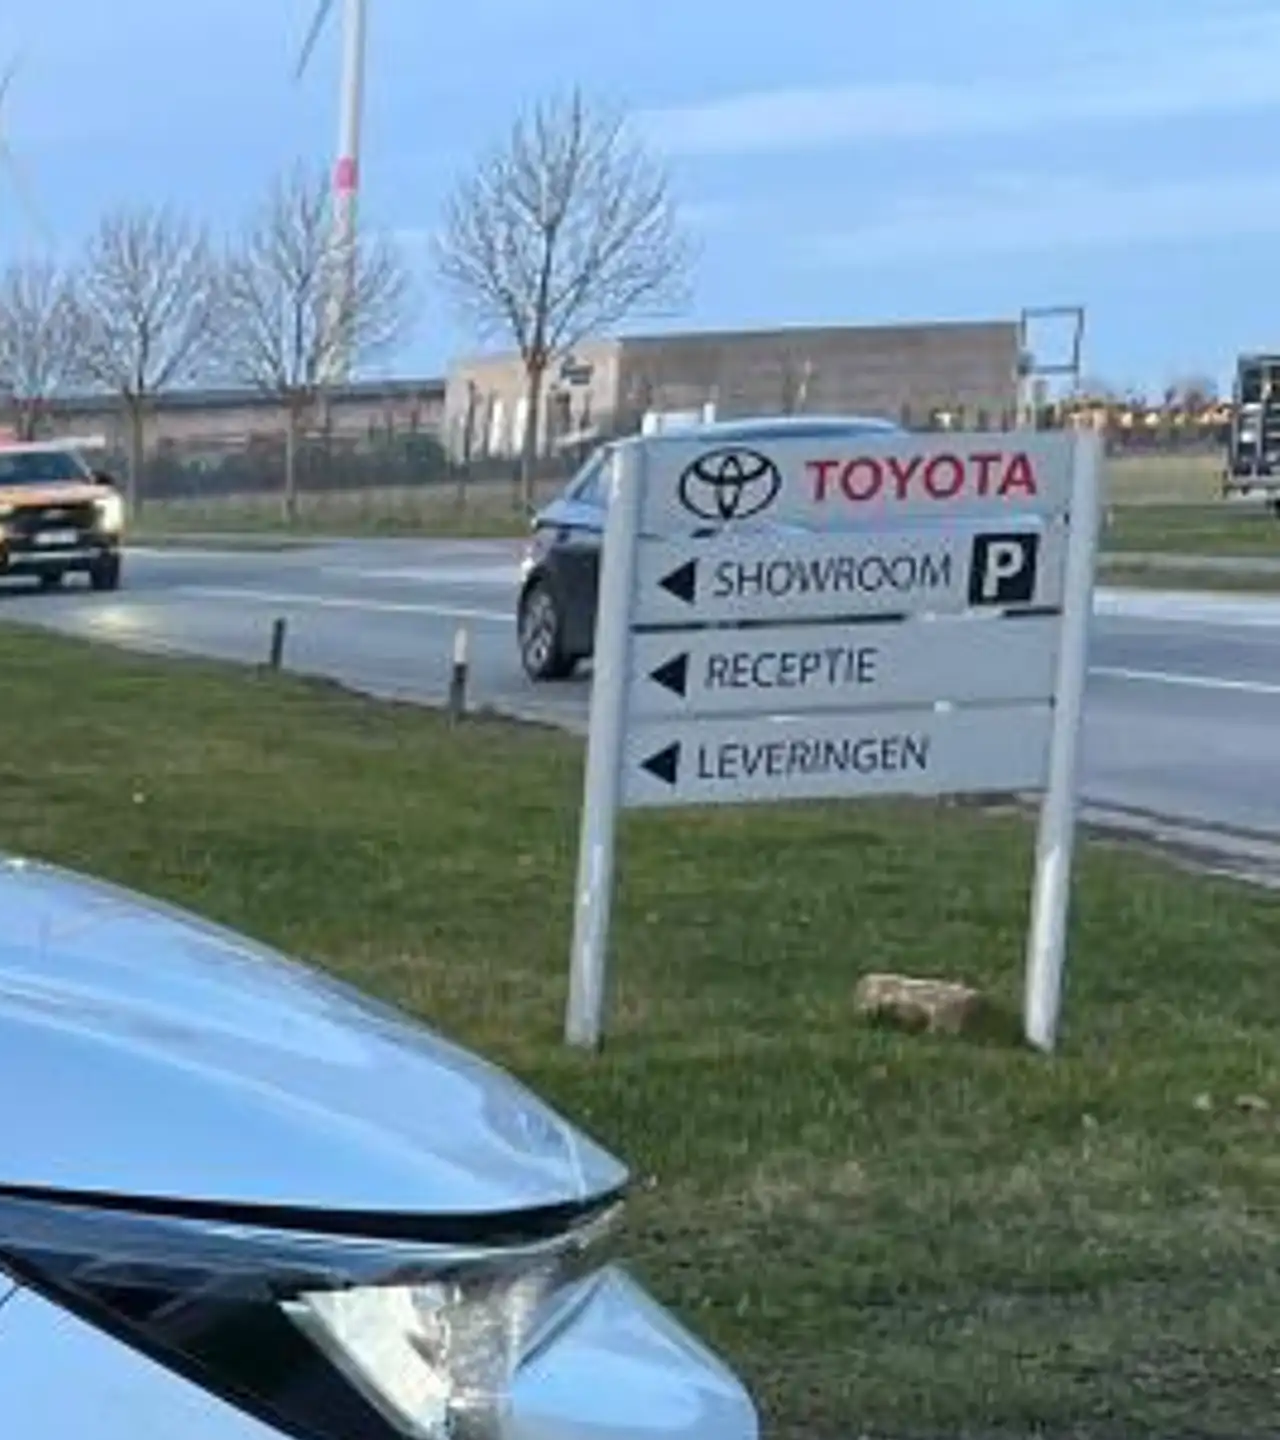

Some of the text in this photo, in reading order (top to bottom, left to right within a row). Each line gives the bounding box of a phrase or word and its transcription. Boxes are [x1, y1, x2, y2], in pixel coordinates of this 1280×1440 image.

[805, 453, 1038, 501] TOYOTA
[712, 541, 1024, 597] SHOWROOM P
[704, 647, 879, 689] RECEPTIE
[696, 736, 932, 780] LEVERINGEN
